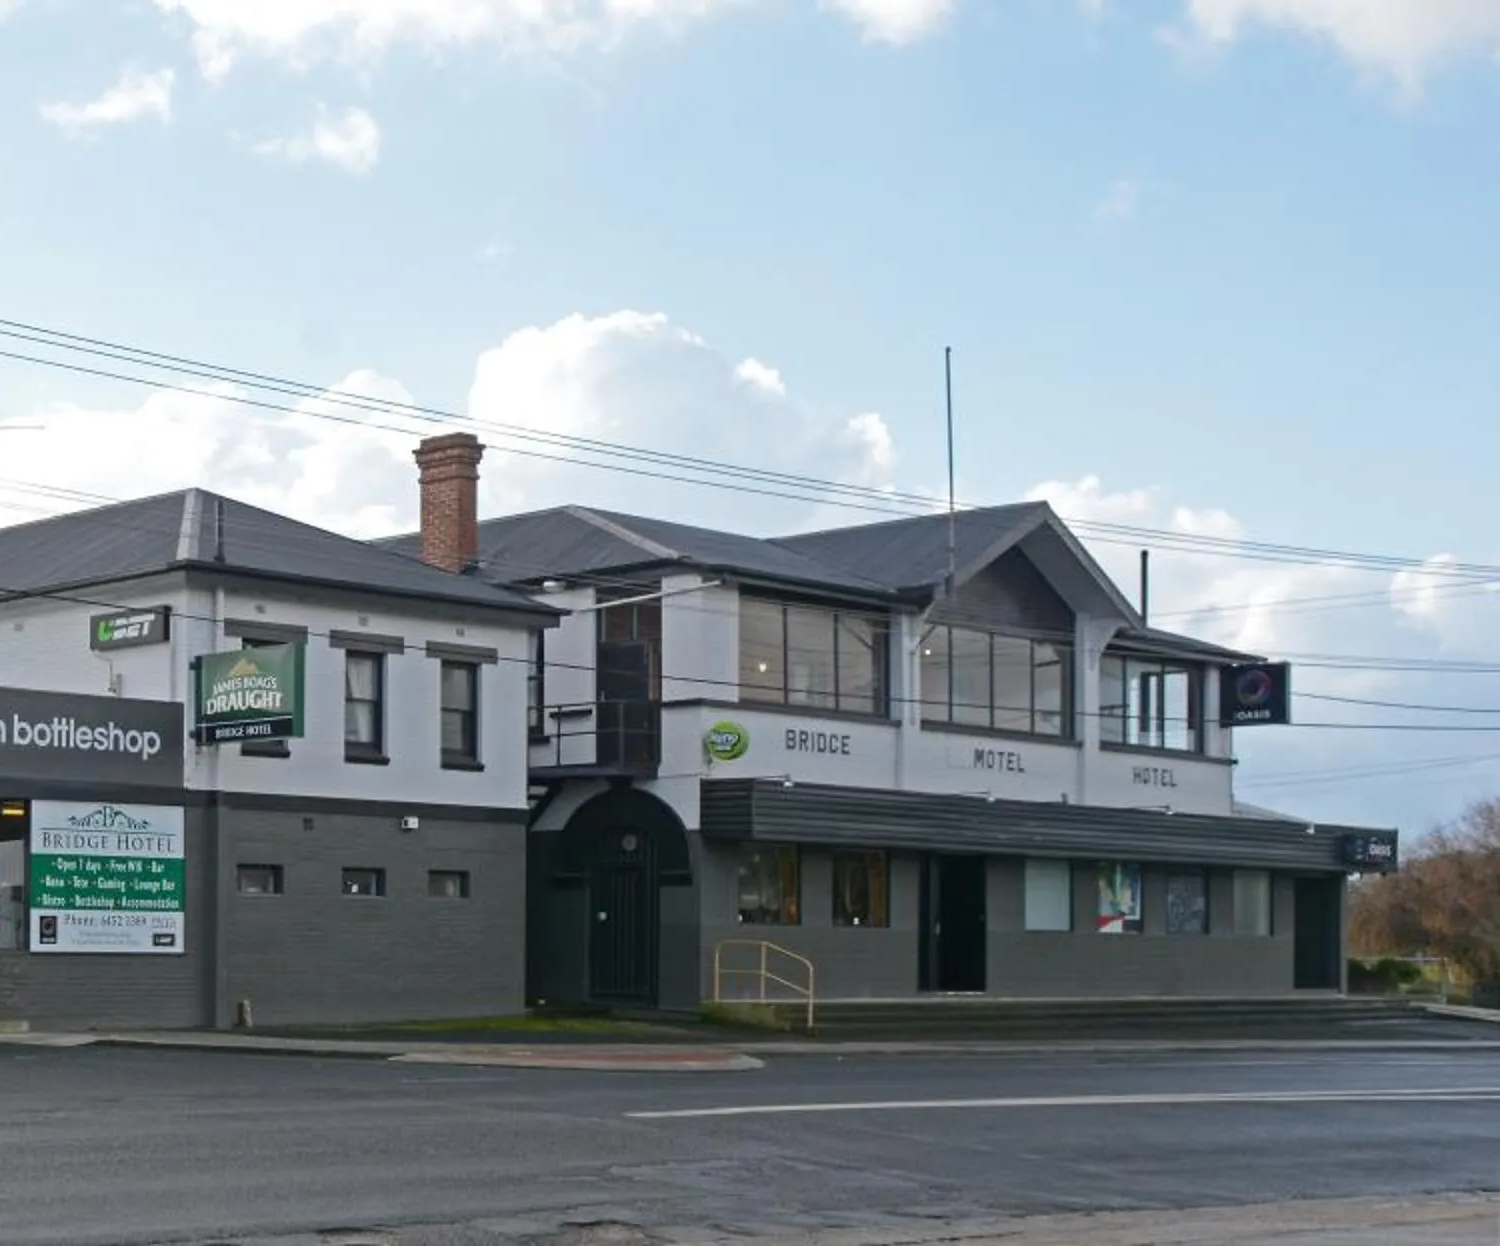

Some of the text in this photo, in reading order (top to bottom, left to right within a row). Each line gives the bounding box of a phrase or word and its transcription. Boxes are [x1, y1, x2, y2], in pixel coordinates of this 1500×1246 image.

[206, 689, 283, 715] DRAUGHT
[13, 714, 162, 760] bottleshop
[246, 724, 271, 736] HOTEL
[973, 748, 1026, 773] MOTEL
[1131, 766, 1178, 788] HOTEL
[42, 831, 177, 853] BRIDGE HOTEL
